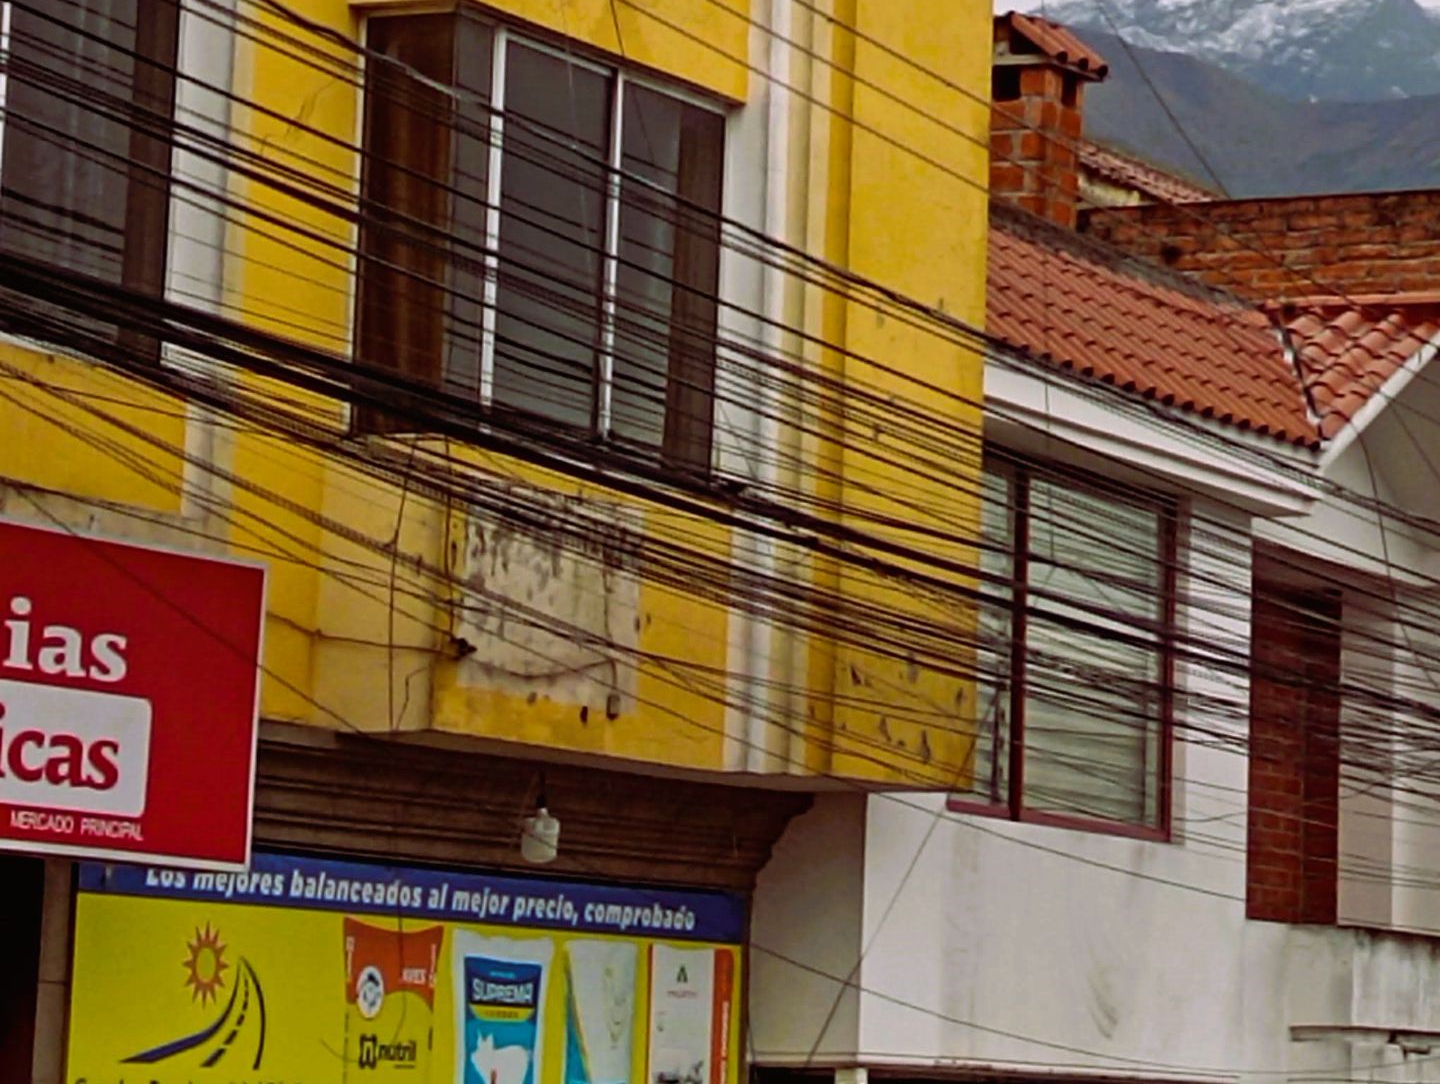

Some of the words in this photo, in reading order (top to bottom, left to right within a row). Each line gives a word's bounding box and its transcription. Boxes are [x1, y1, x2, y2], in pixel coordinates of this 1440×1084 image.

[3, 596, 128, 683] ias
[0, 701, 120, 791] cas
[10, 809, 74, 834] MERCADO
[80, 817, 144, 841] PRINCIPAL
[193, 869, 284, 899] mejores
[290, 870, 423, 909] balanceados
[428, 883, 449, 910] al
[452, 887, 511, 919] mejor
[513, 893, 579, 927] precio,
[584, 901, 696, 931] comprobado
[472, 978, 534, 1004] SUPREMA
